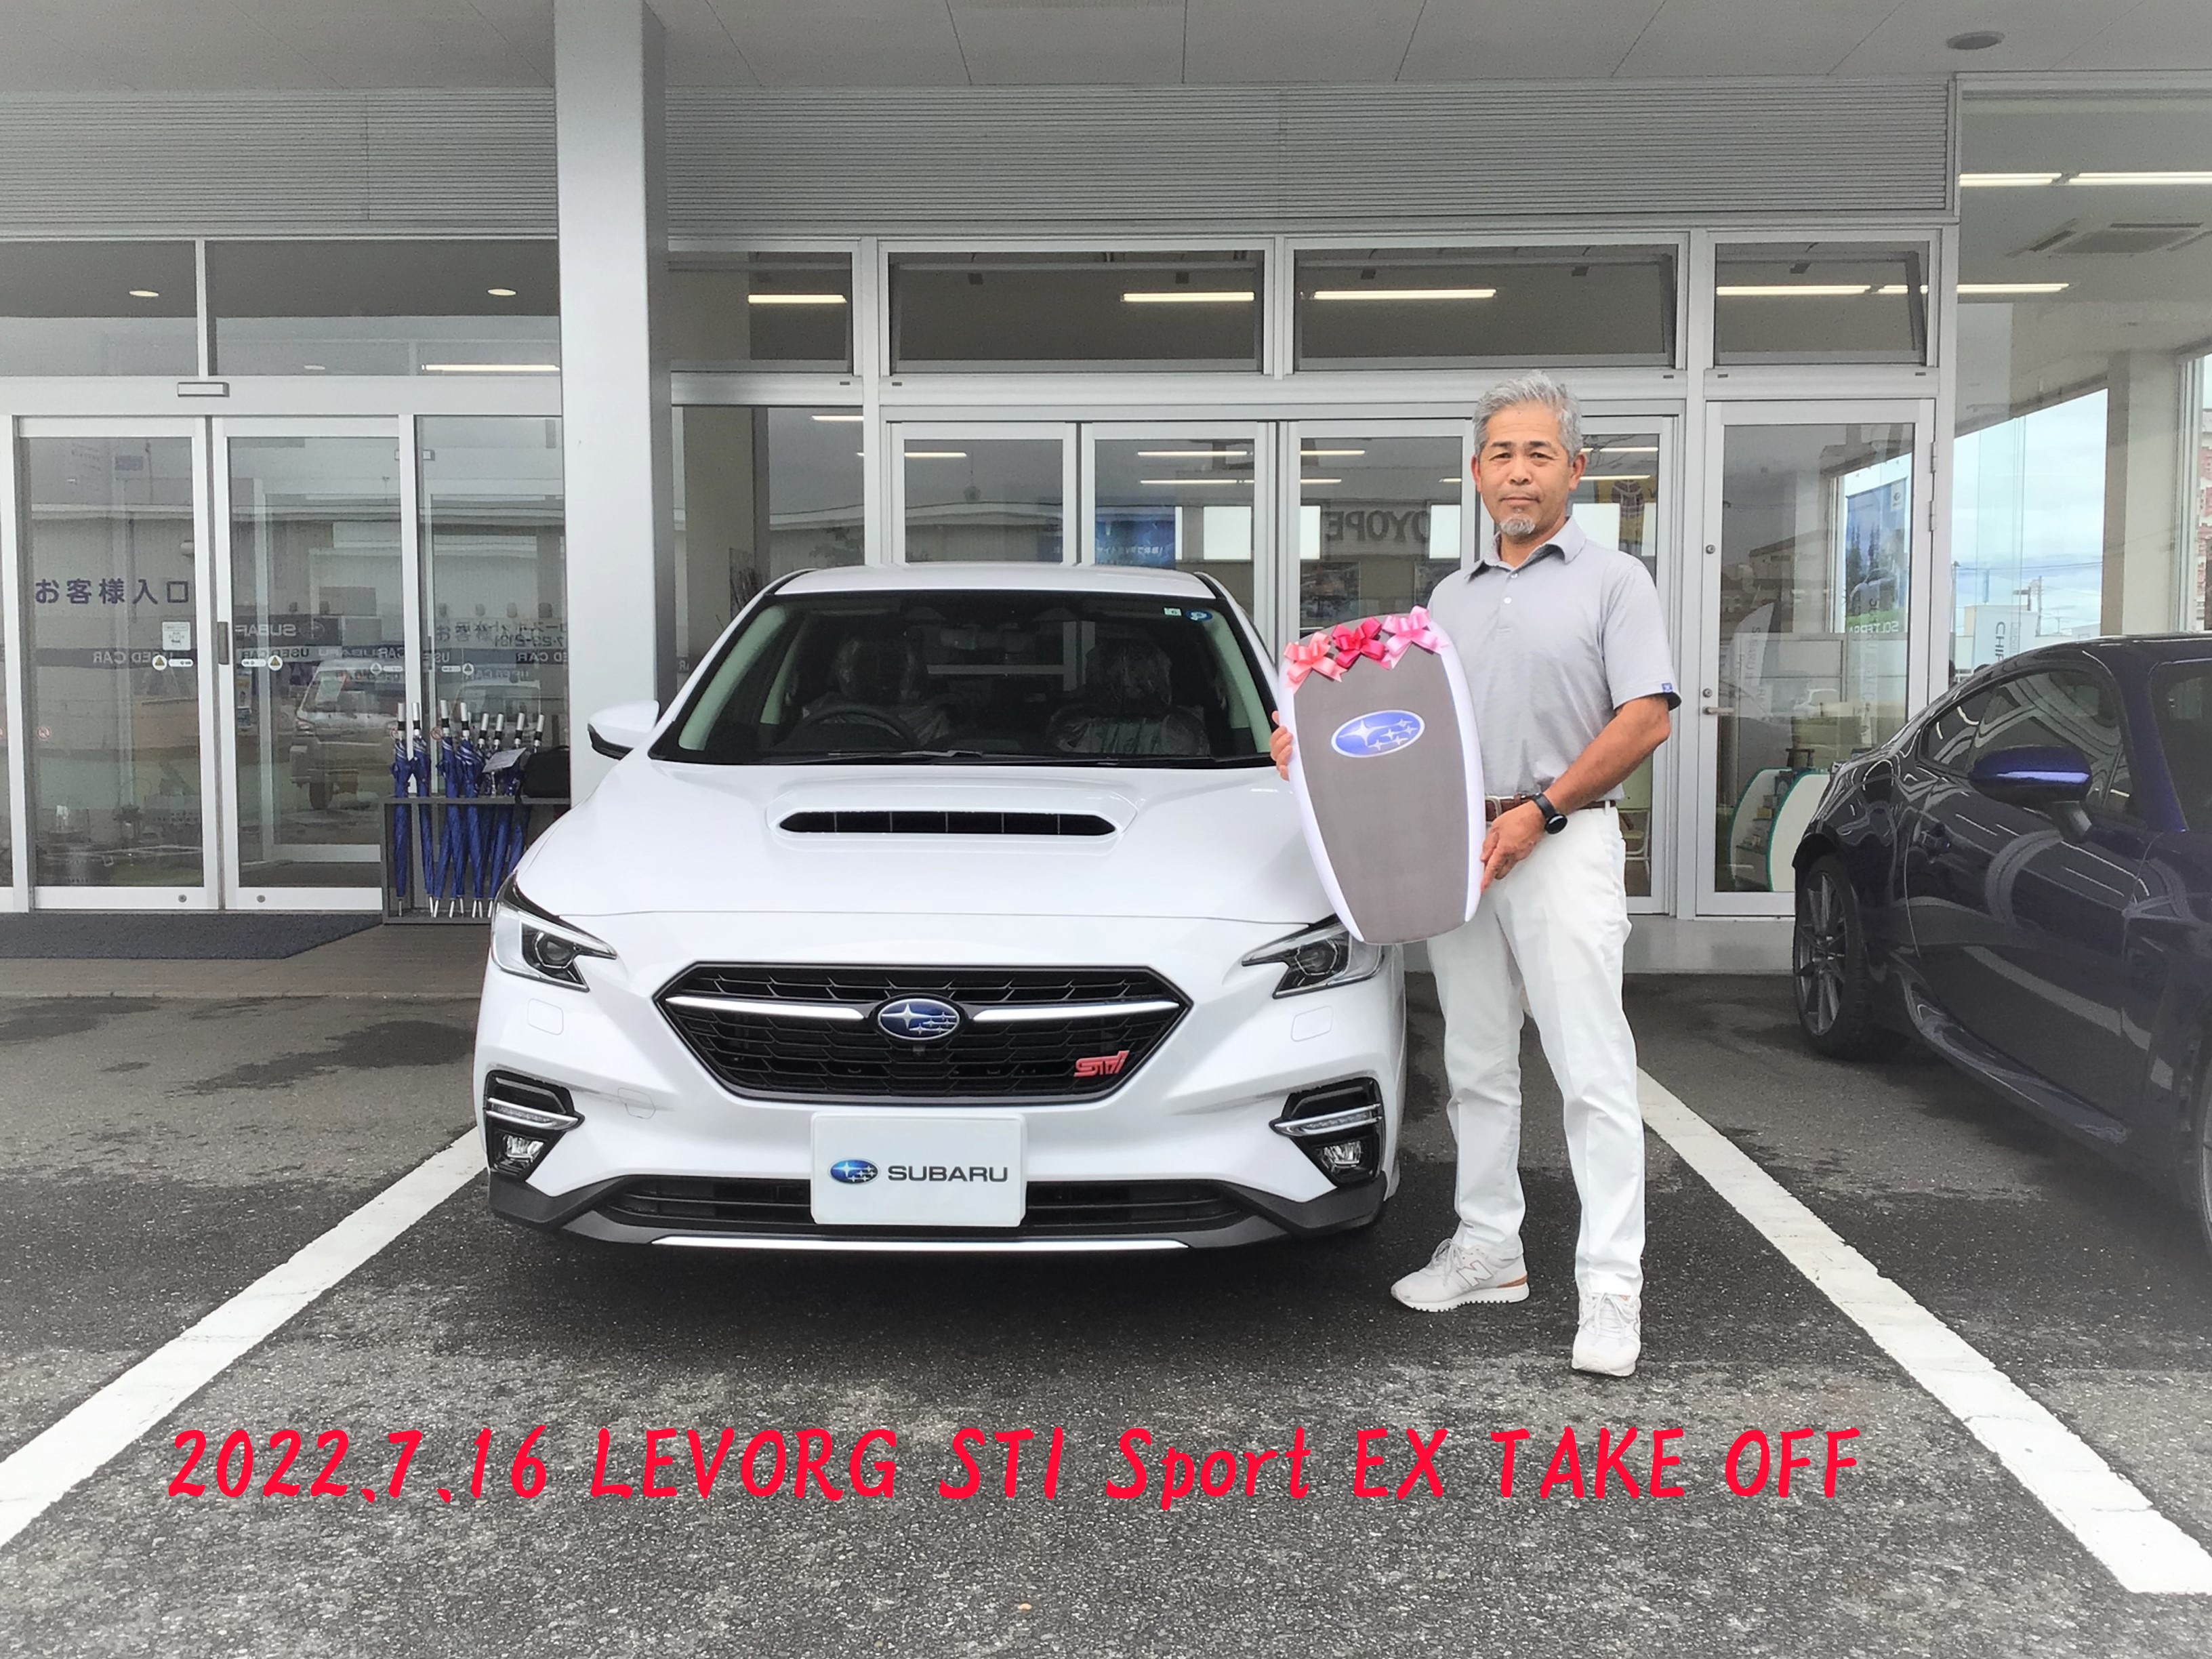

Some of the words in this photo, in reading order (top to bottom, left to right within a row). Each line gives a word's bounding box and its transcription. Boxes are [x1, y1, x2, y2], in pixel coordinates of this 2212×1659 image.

[35, 578, 189, 605] お客様入口
[888, 1165, 1008, 1182] SUBARU
